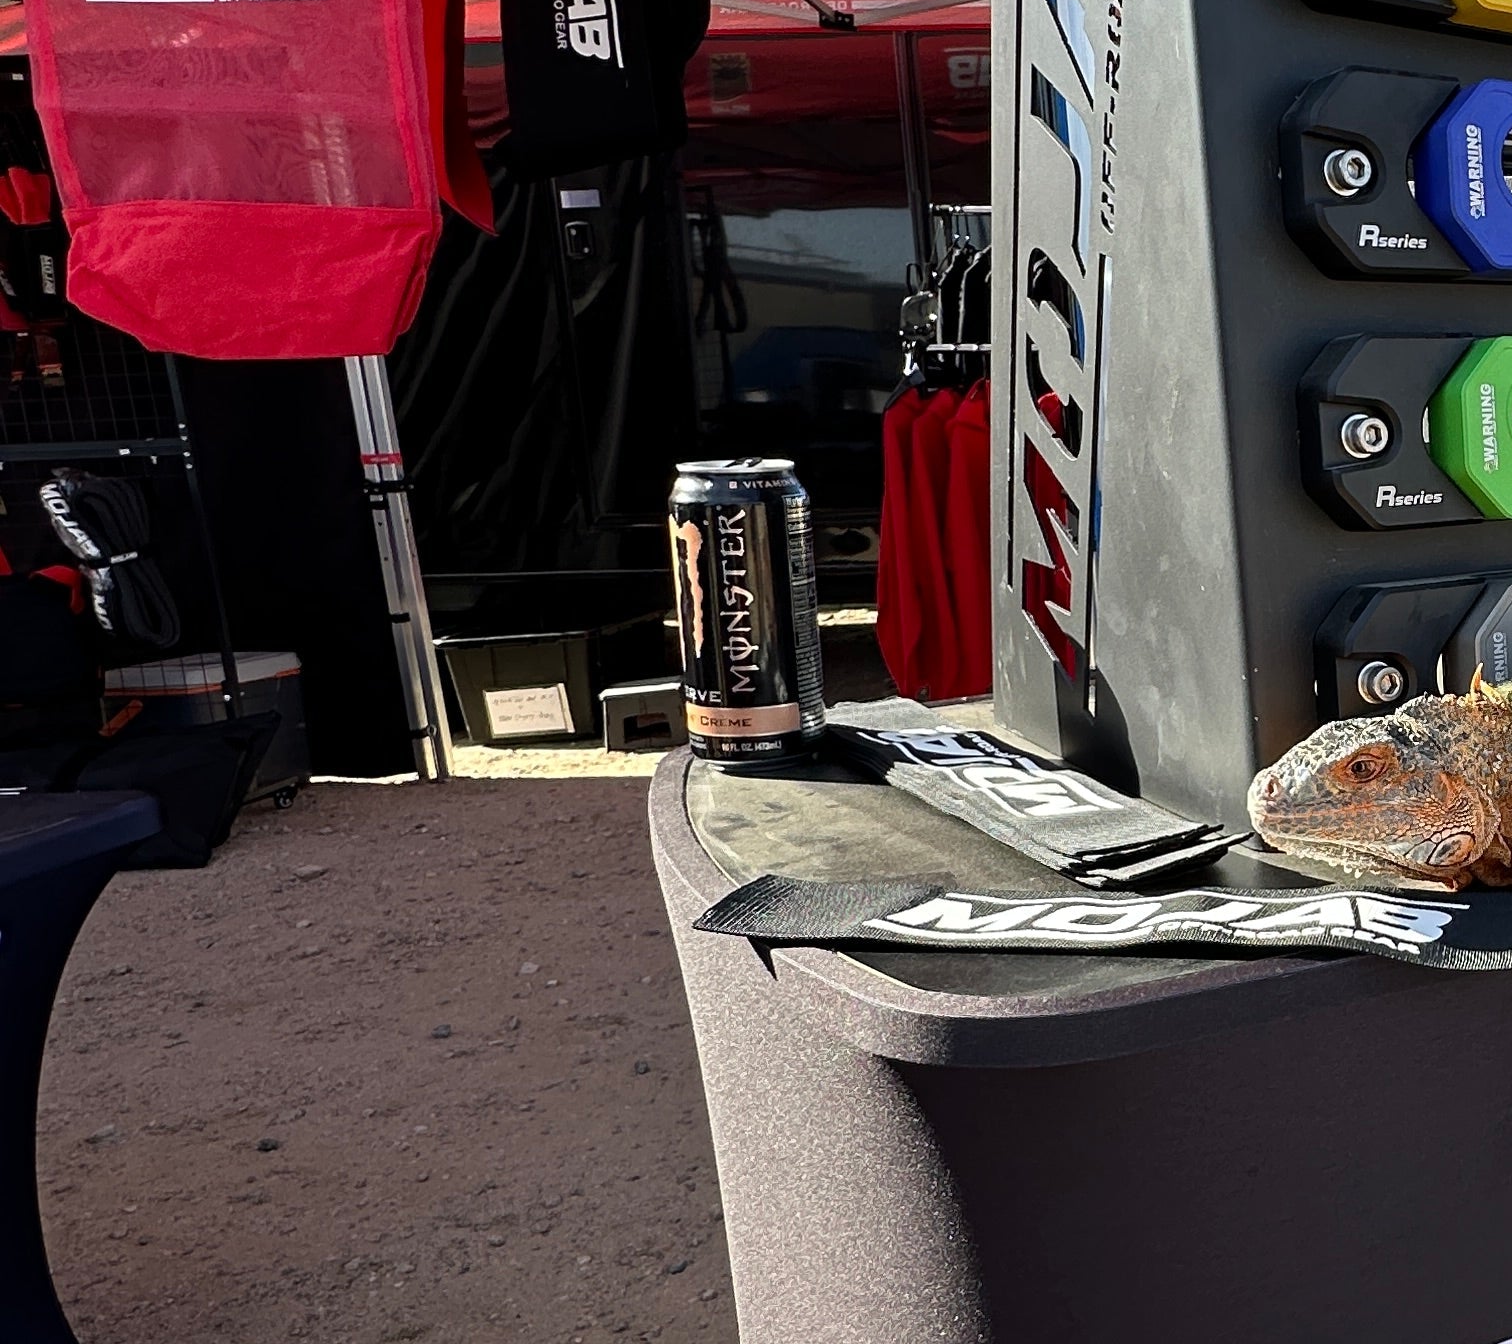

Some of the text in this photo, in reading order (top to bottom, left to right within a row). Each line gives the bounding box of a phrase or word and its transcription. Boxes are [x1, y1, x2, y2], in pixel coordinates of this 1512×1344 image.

[554, 11, 568, 50] GEAR
[1467, 124, 1479, 208] WARNING
[1480, 383, 1493, 466] WARNING
[719, 508, 760, 694] MONSTER
[881, 895, 1454, 944] MOJAB
